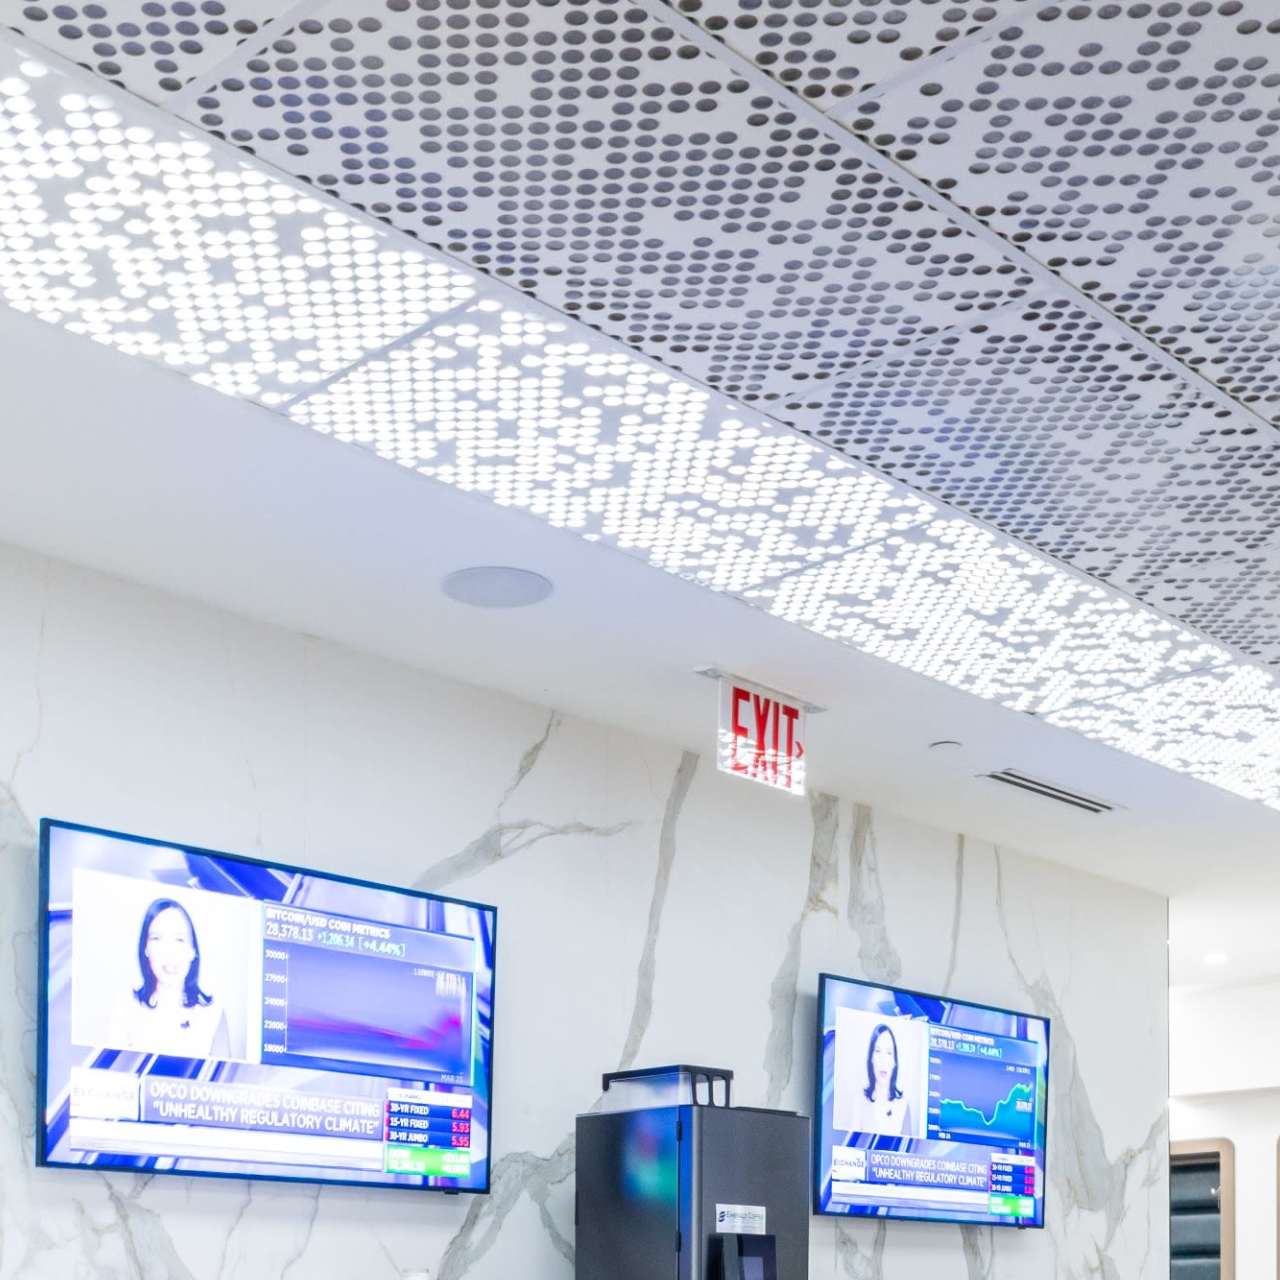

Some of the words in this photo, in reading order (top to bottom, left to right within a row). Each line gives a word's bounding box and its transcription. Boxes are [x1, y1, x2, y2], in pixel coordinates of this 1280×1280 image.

[732, 687, 799, 787] EXIT
[150, 1081, 187, 1099] OPCO
[190, 1085, 280, 1109] DOWNGRADES
[283, 1095, 341, 1114] COINBASE
[344, 1101, 379, 1118] CITING
[153, 1100, 238, 1123] "UNHEALTHY
[240, 1108, 321, 1130] REGULATORY
[324, 1116, 380, 1135] CLIMATE"
